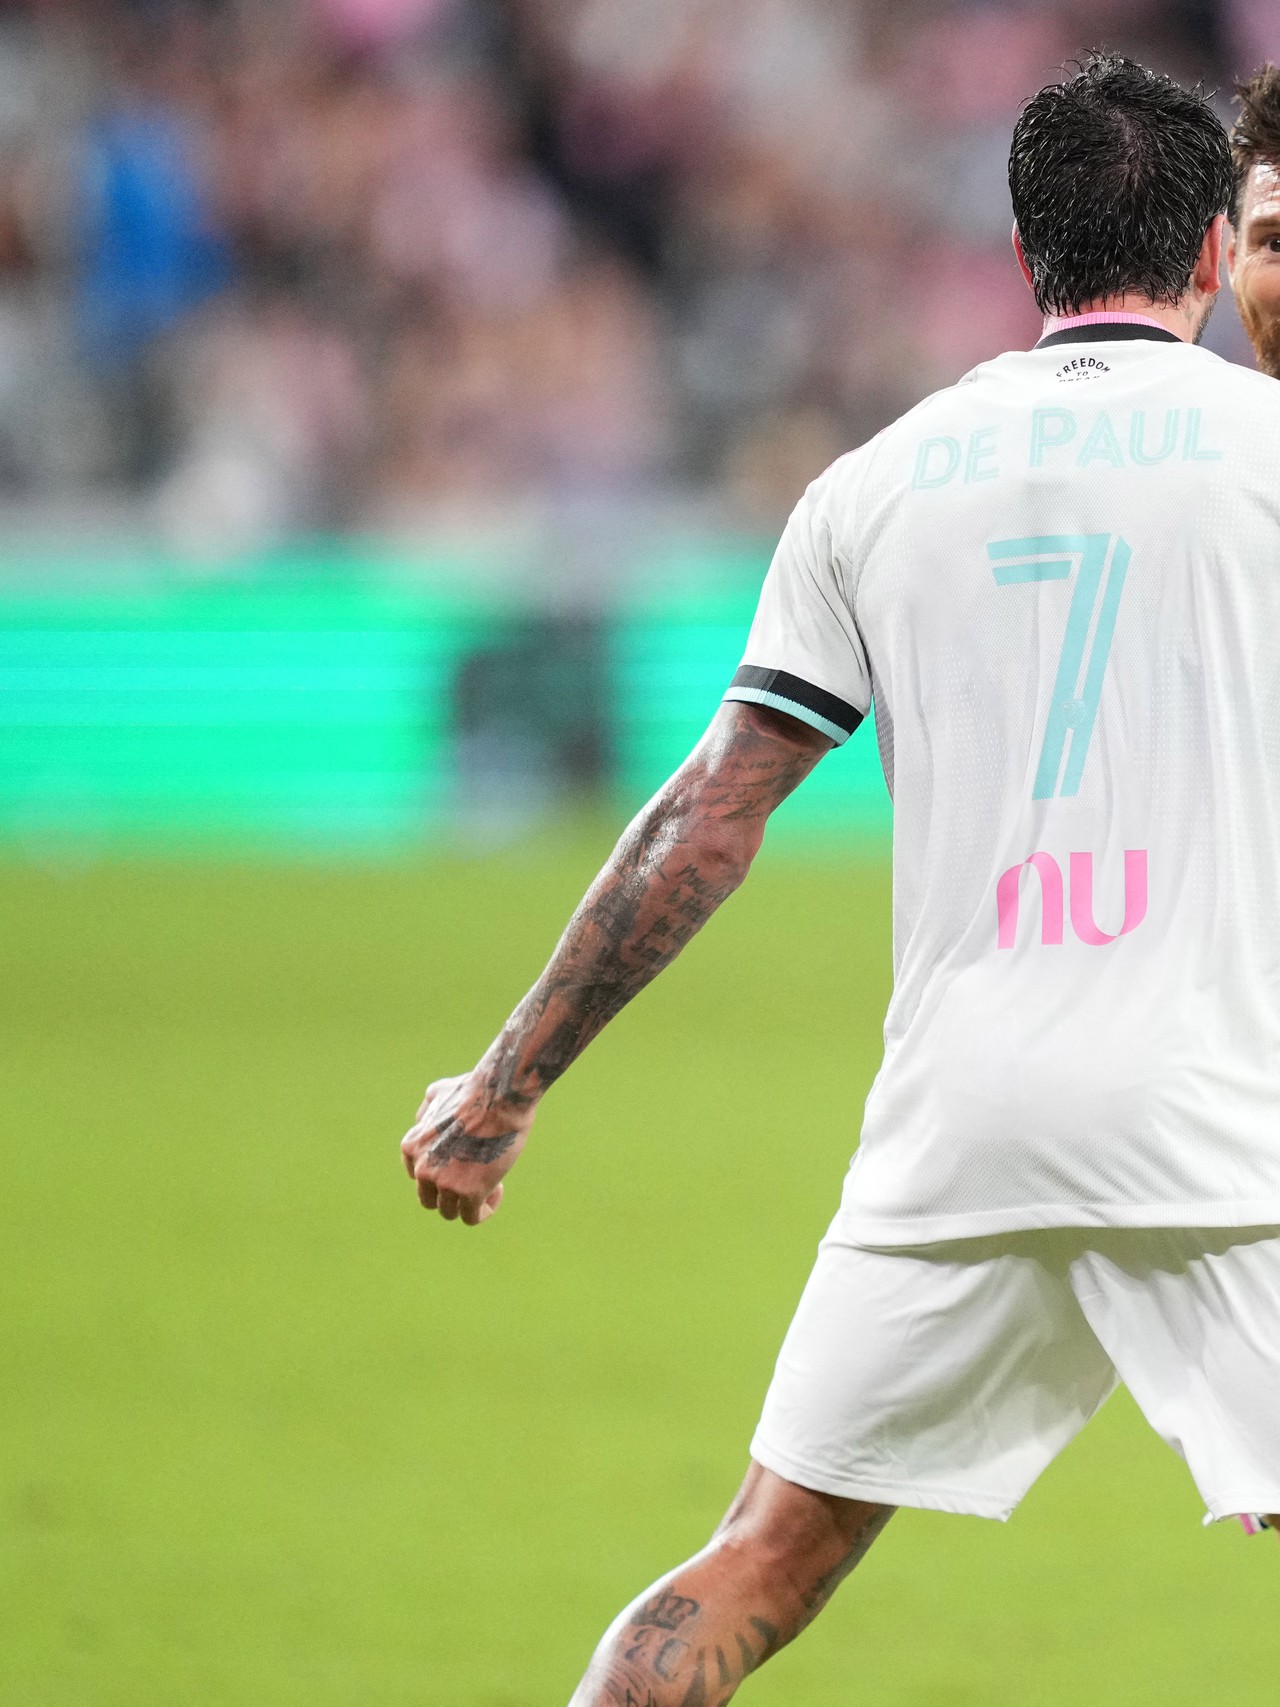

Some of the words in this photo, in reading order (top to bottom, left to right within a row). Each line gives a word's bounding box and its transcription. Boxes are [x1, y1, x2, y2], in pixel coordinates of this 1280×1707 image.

[1056, 357, 1110, 377] FREEDOM
[912, 423, 1003, 490] DE
[1029, 406, 1224, 469] PAUL
[986, 533, 1132, 801] 7
